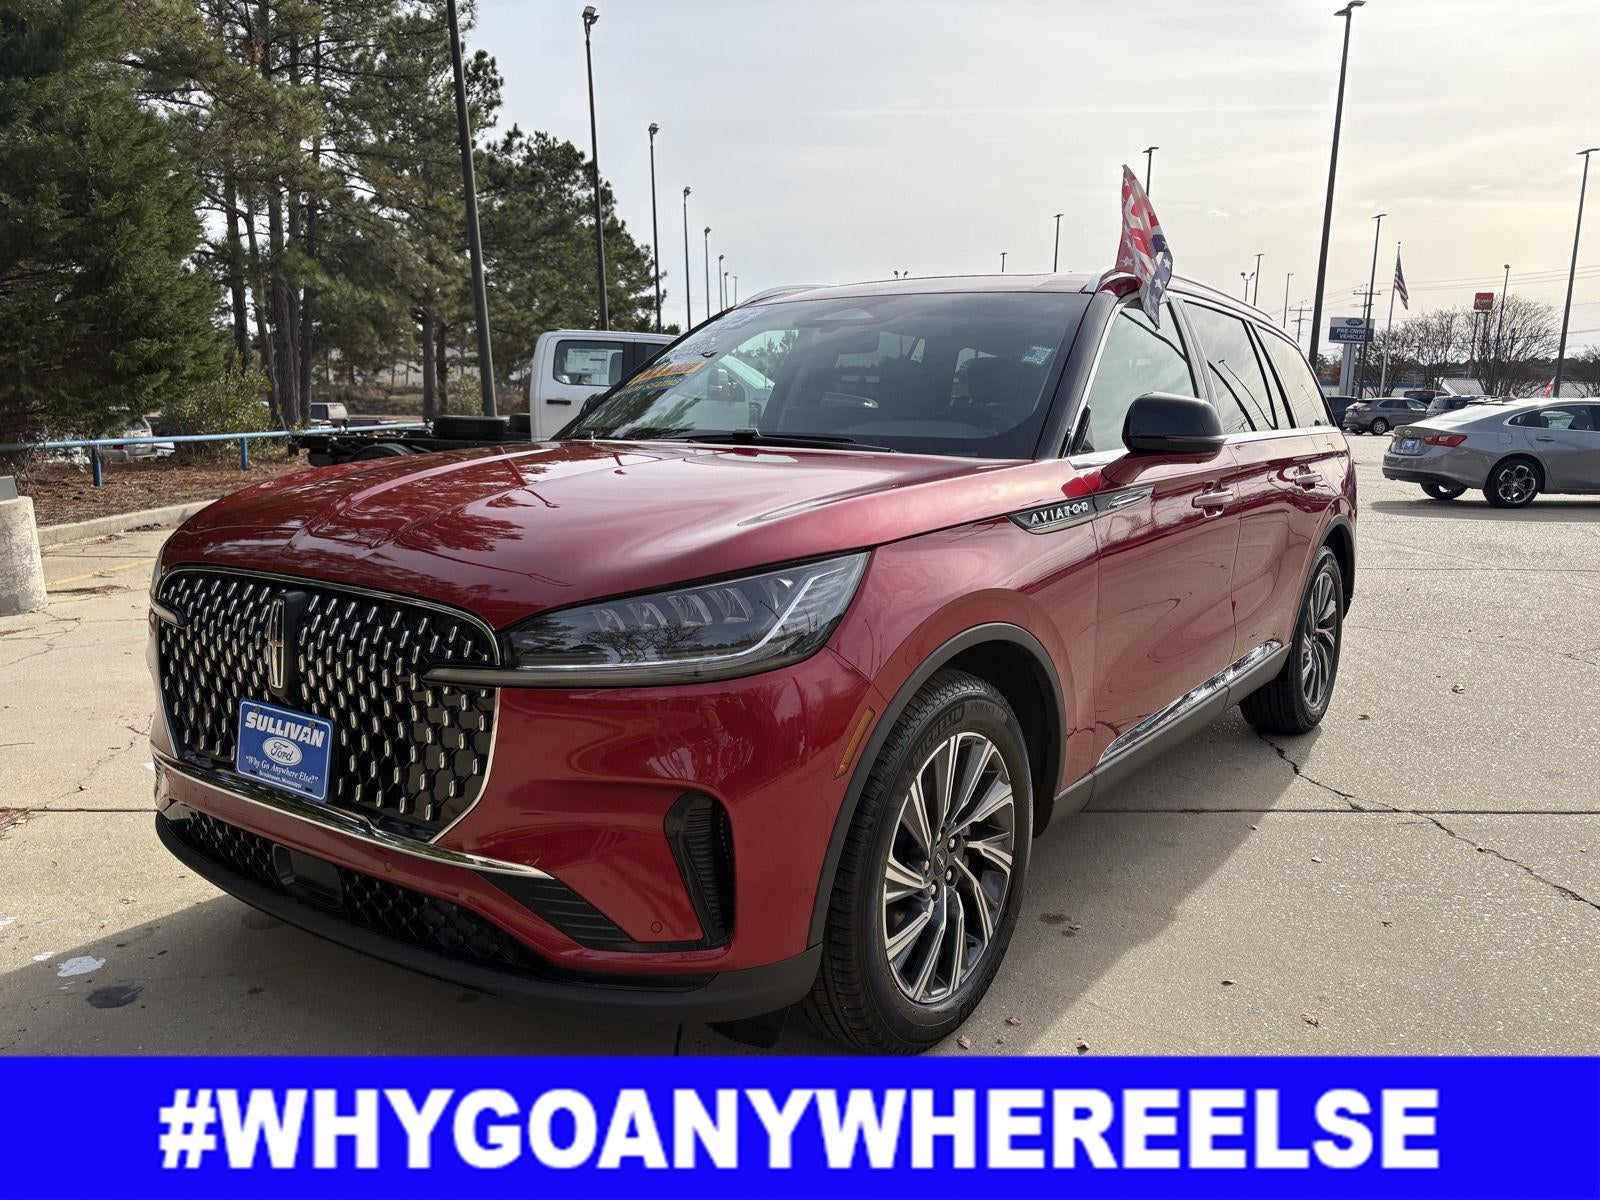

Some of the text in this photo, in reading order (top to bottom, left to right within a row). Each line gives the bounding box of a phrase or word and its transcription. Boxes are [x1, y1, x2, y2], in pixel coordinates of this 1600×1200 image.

[1030, 502, 1089, 525] AVIATOR
[245, 711, 325, 747] SULLIVAN
[912, 706, 962, 769] MICHELIN
[270, 741, 294, 762] Ford
[261, 760, 270, 769] Go
[271, 764, 299, 779] Anywhere
